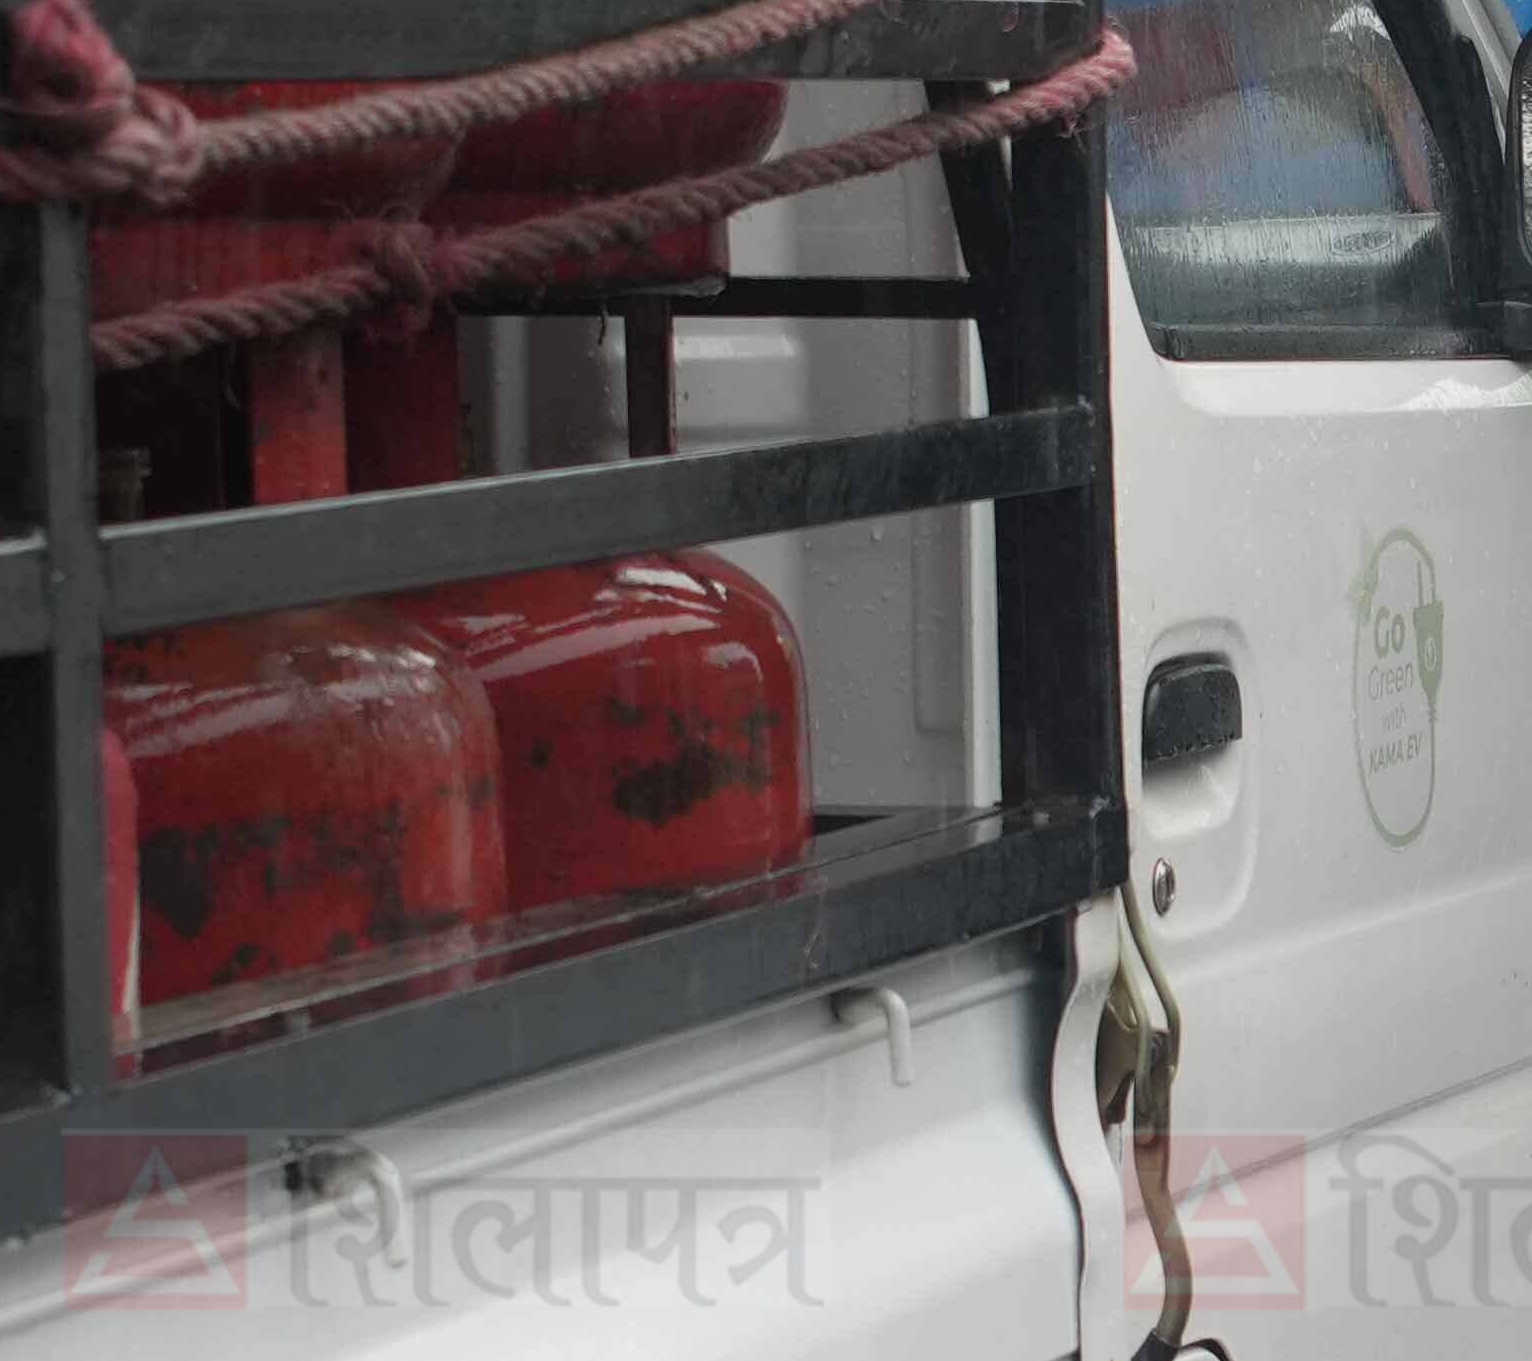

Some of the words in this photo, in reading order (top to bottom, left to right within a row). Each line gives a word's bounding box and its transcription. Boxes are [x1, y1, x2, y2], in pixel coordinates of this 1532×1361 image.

[1374, 605, 1405, 659] Go
[1369, 662, 1414, 701] Green
[1381, 707, 1407, 732] with
